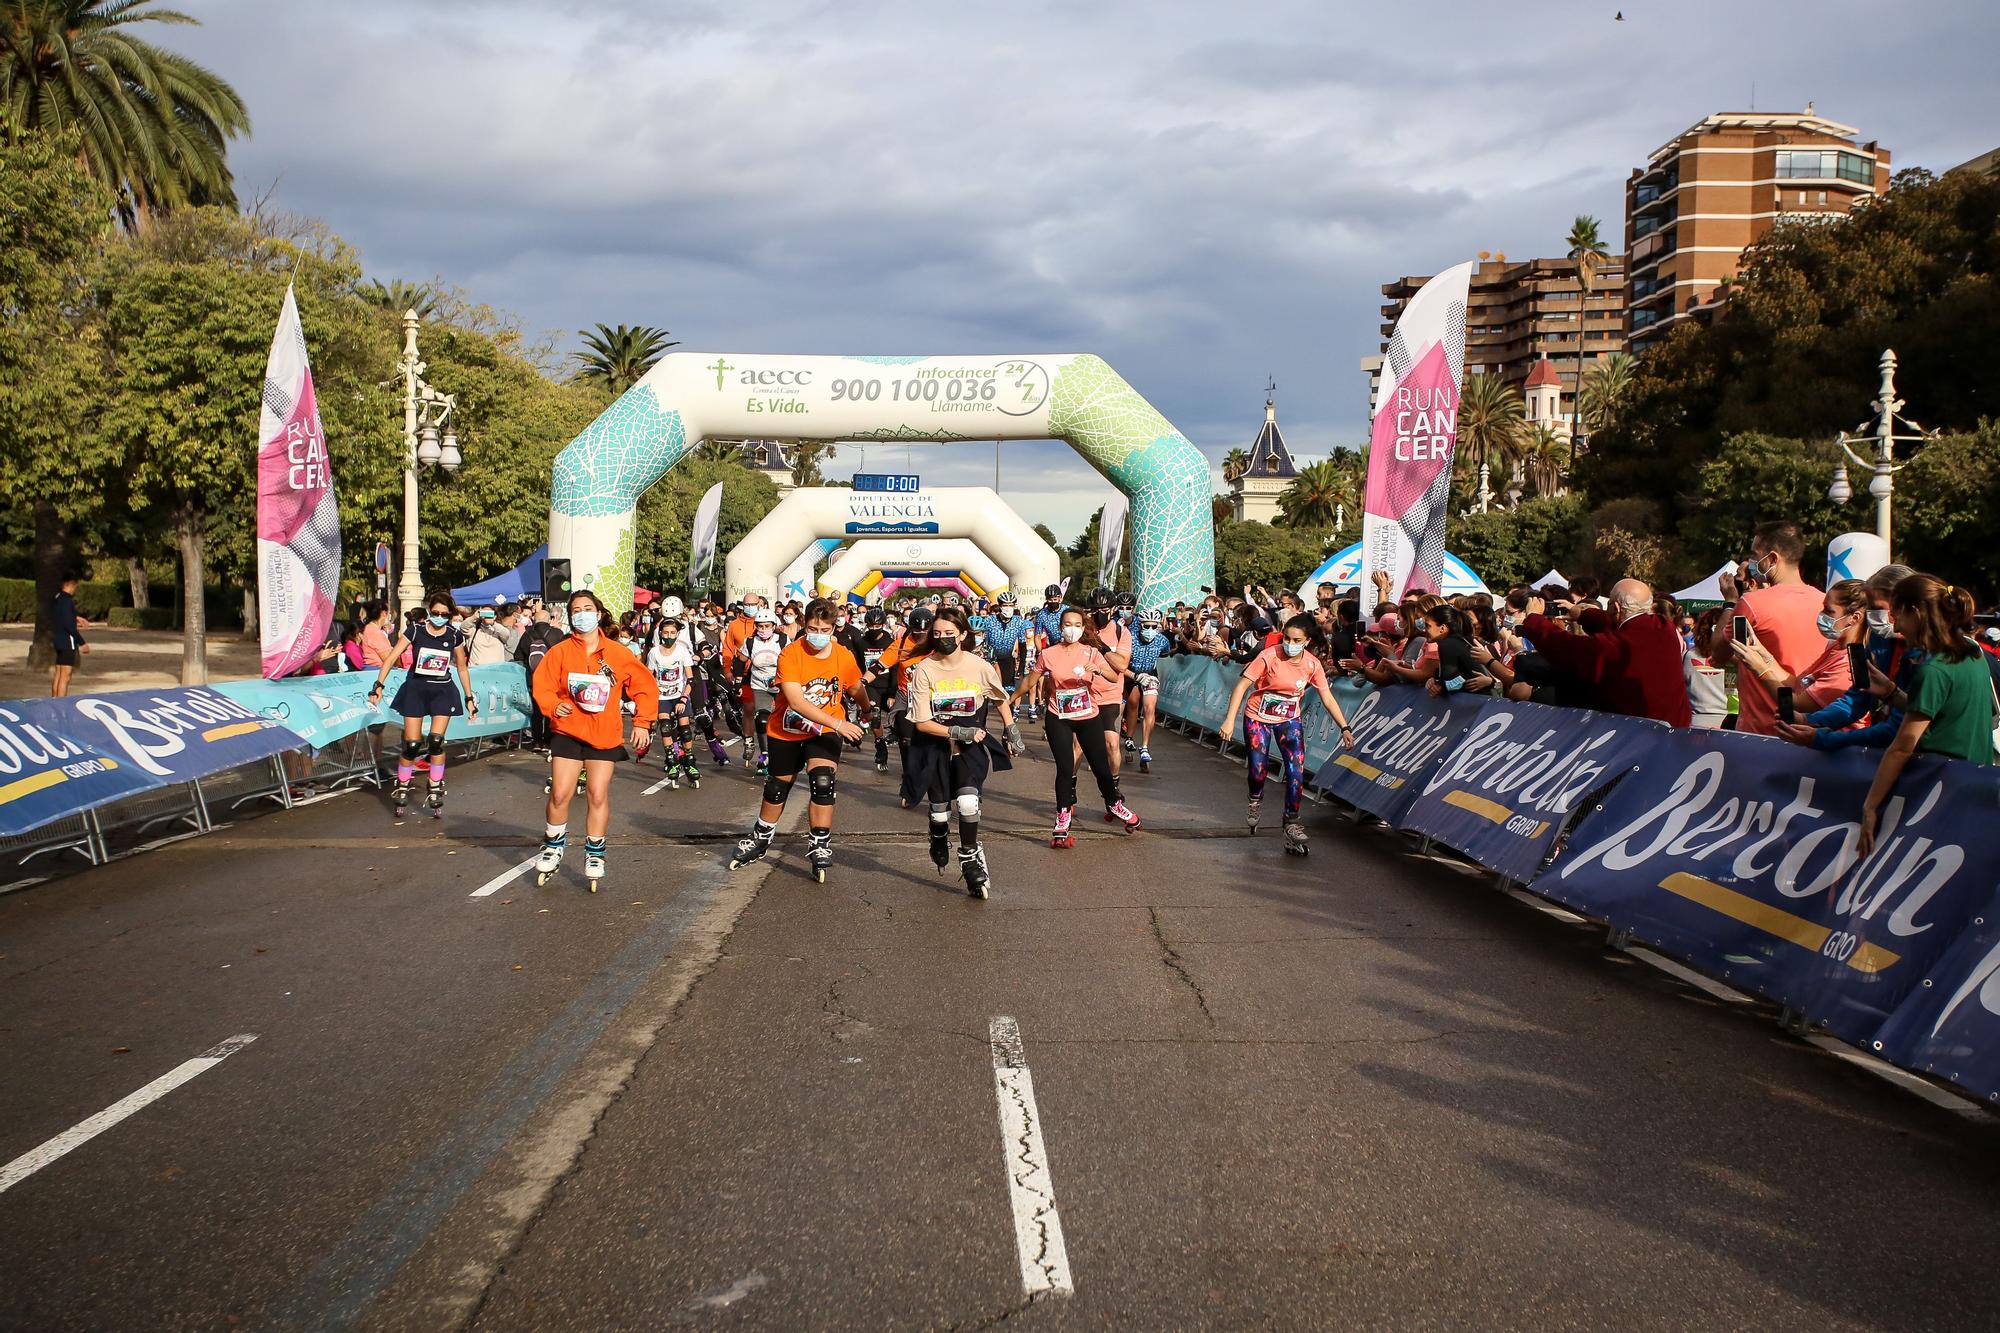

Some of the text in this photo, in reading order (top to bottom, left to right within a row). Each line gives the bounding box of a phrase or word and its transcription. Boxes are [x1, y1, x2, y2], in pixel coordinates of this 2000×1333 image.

[917, 367, 998, 378] infocáncer
[1005, 364, 1024, 373] 24
[740, 370, 812, 385] aecc
[831, 379, 996, 401] 900 100 036
[1022, 383, 1035, 400] 7
[747, 398, 809, 413] Es Vida.
[1398, 387, 1450, 410] RUN
[931, 400, 995, 413] Llámame.
[1397, 410, 1456, 435] CAN
[1395, 436, 1447, 460] CER
[288, 464, 328, 489] CER
[850, 502, 934, 516] VALÈNCIA
[1372, 526, 1381, 571] ROVINCIAL
[1381, 524, 1390, 569] VALENCIA
[1017, 586, 1045, 596] Valènc
[429, 659, 444, 668] 153
[584, 688, 599, 701] 69
[1071, 698, 1083, 709] 44
[1275, 704, 1290, 715] 45
[62, 759, 106, 778] GRUPO
